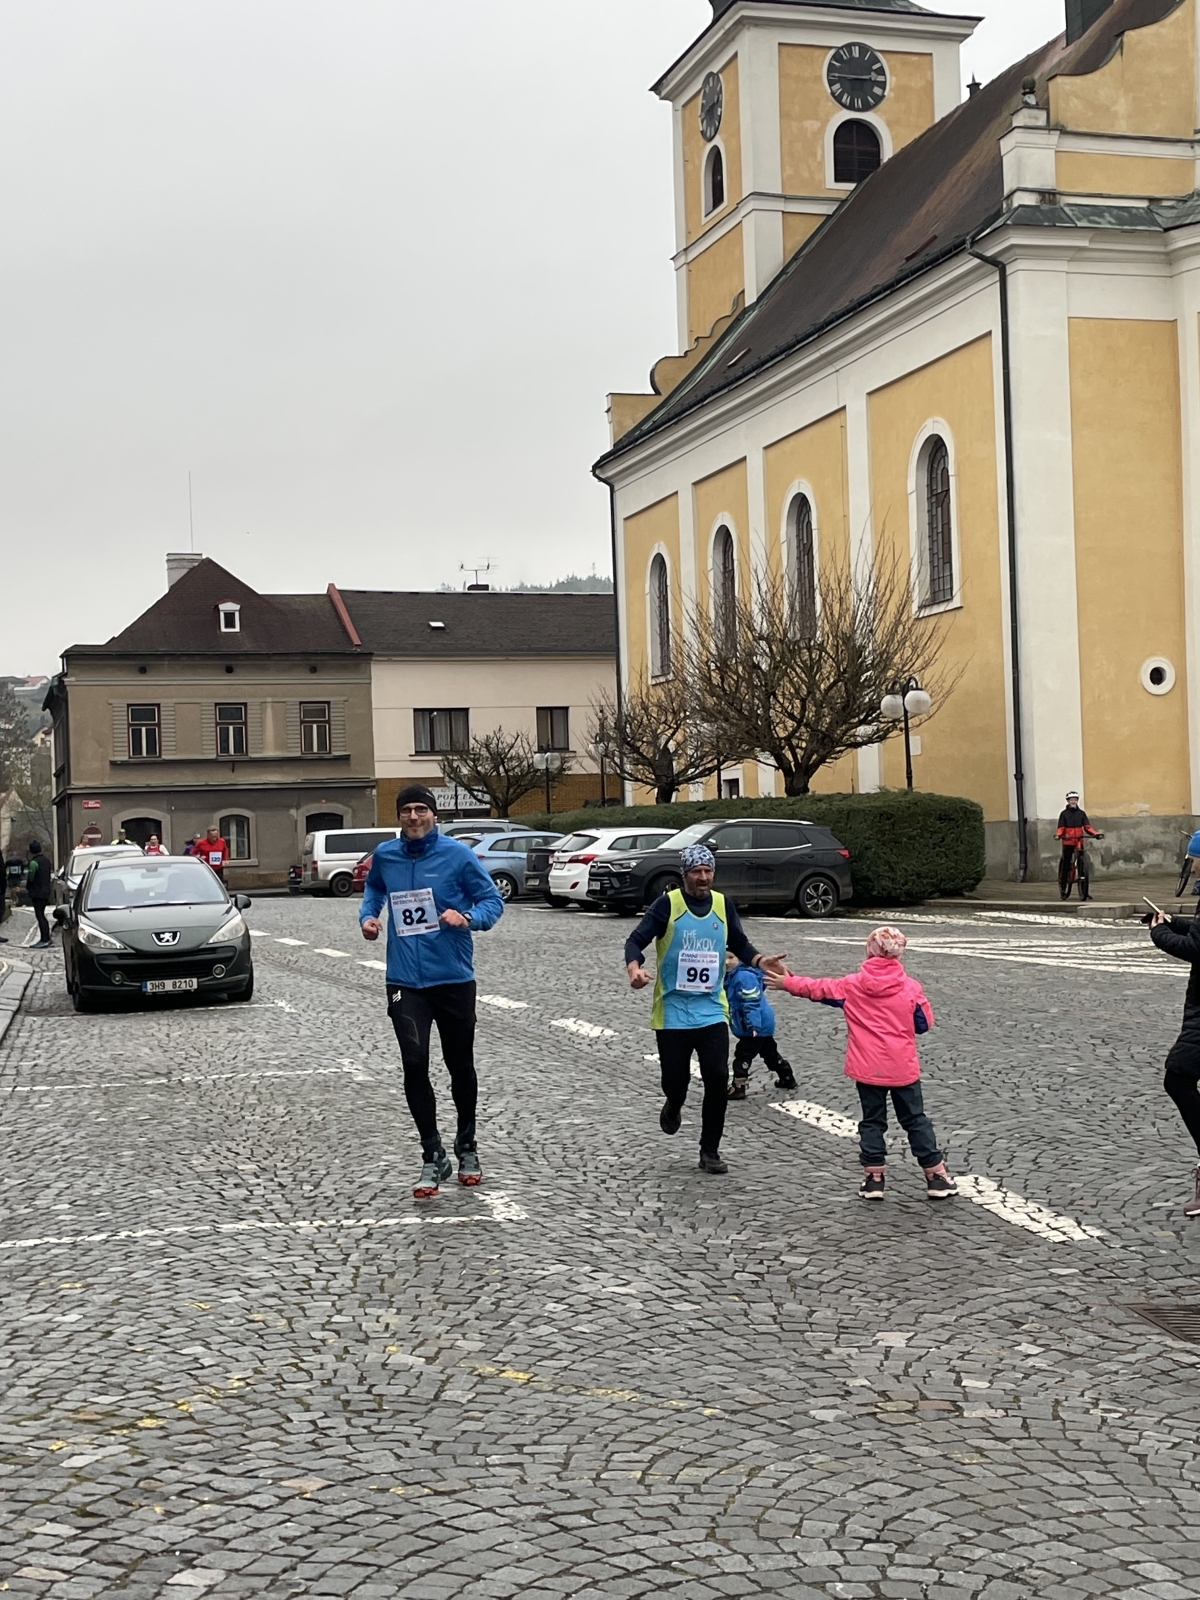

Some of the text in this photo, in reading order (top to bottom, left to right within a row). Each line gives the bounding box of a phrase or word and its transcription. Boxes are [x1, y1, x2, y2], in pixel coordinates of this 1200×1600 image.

[402, 906, 428, 926] 82
[683, 929, 697, 939] THE
[686, 966, 711, 984] 96
[149, 979, 194, 991] 3H9 8210
